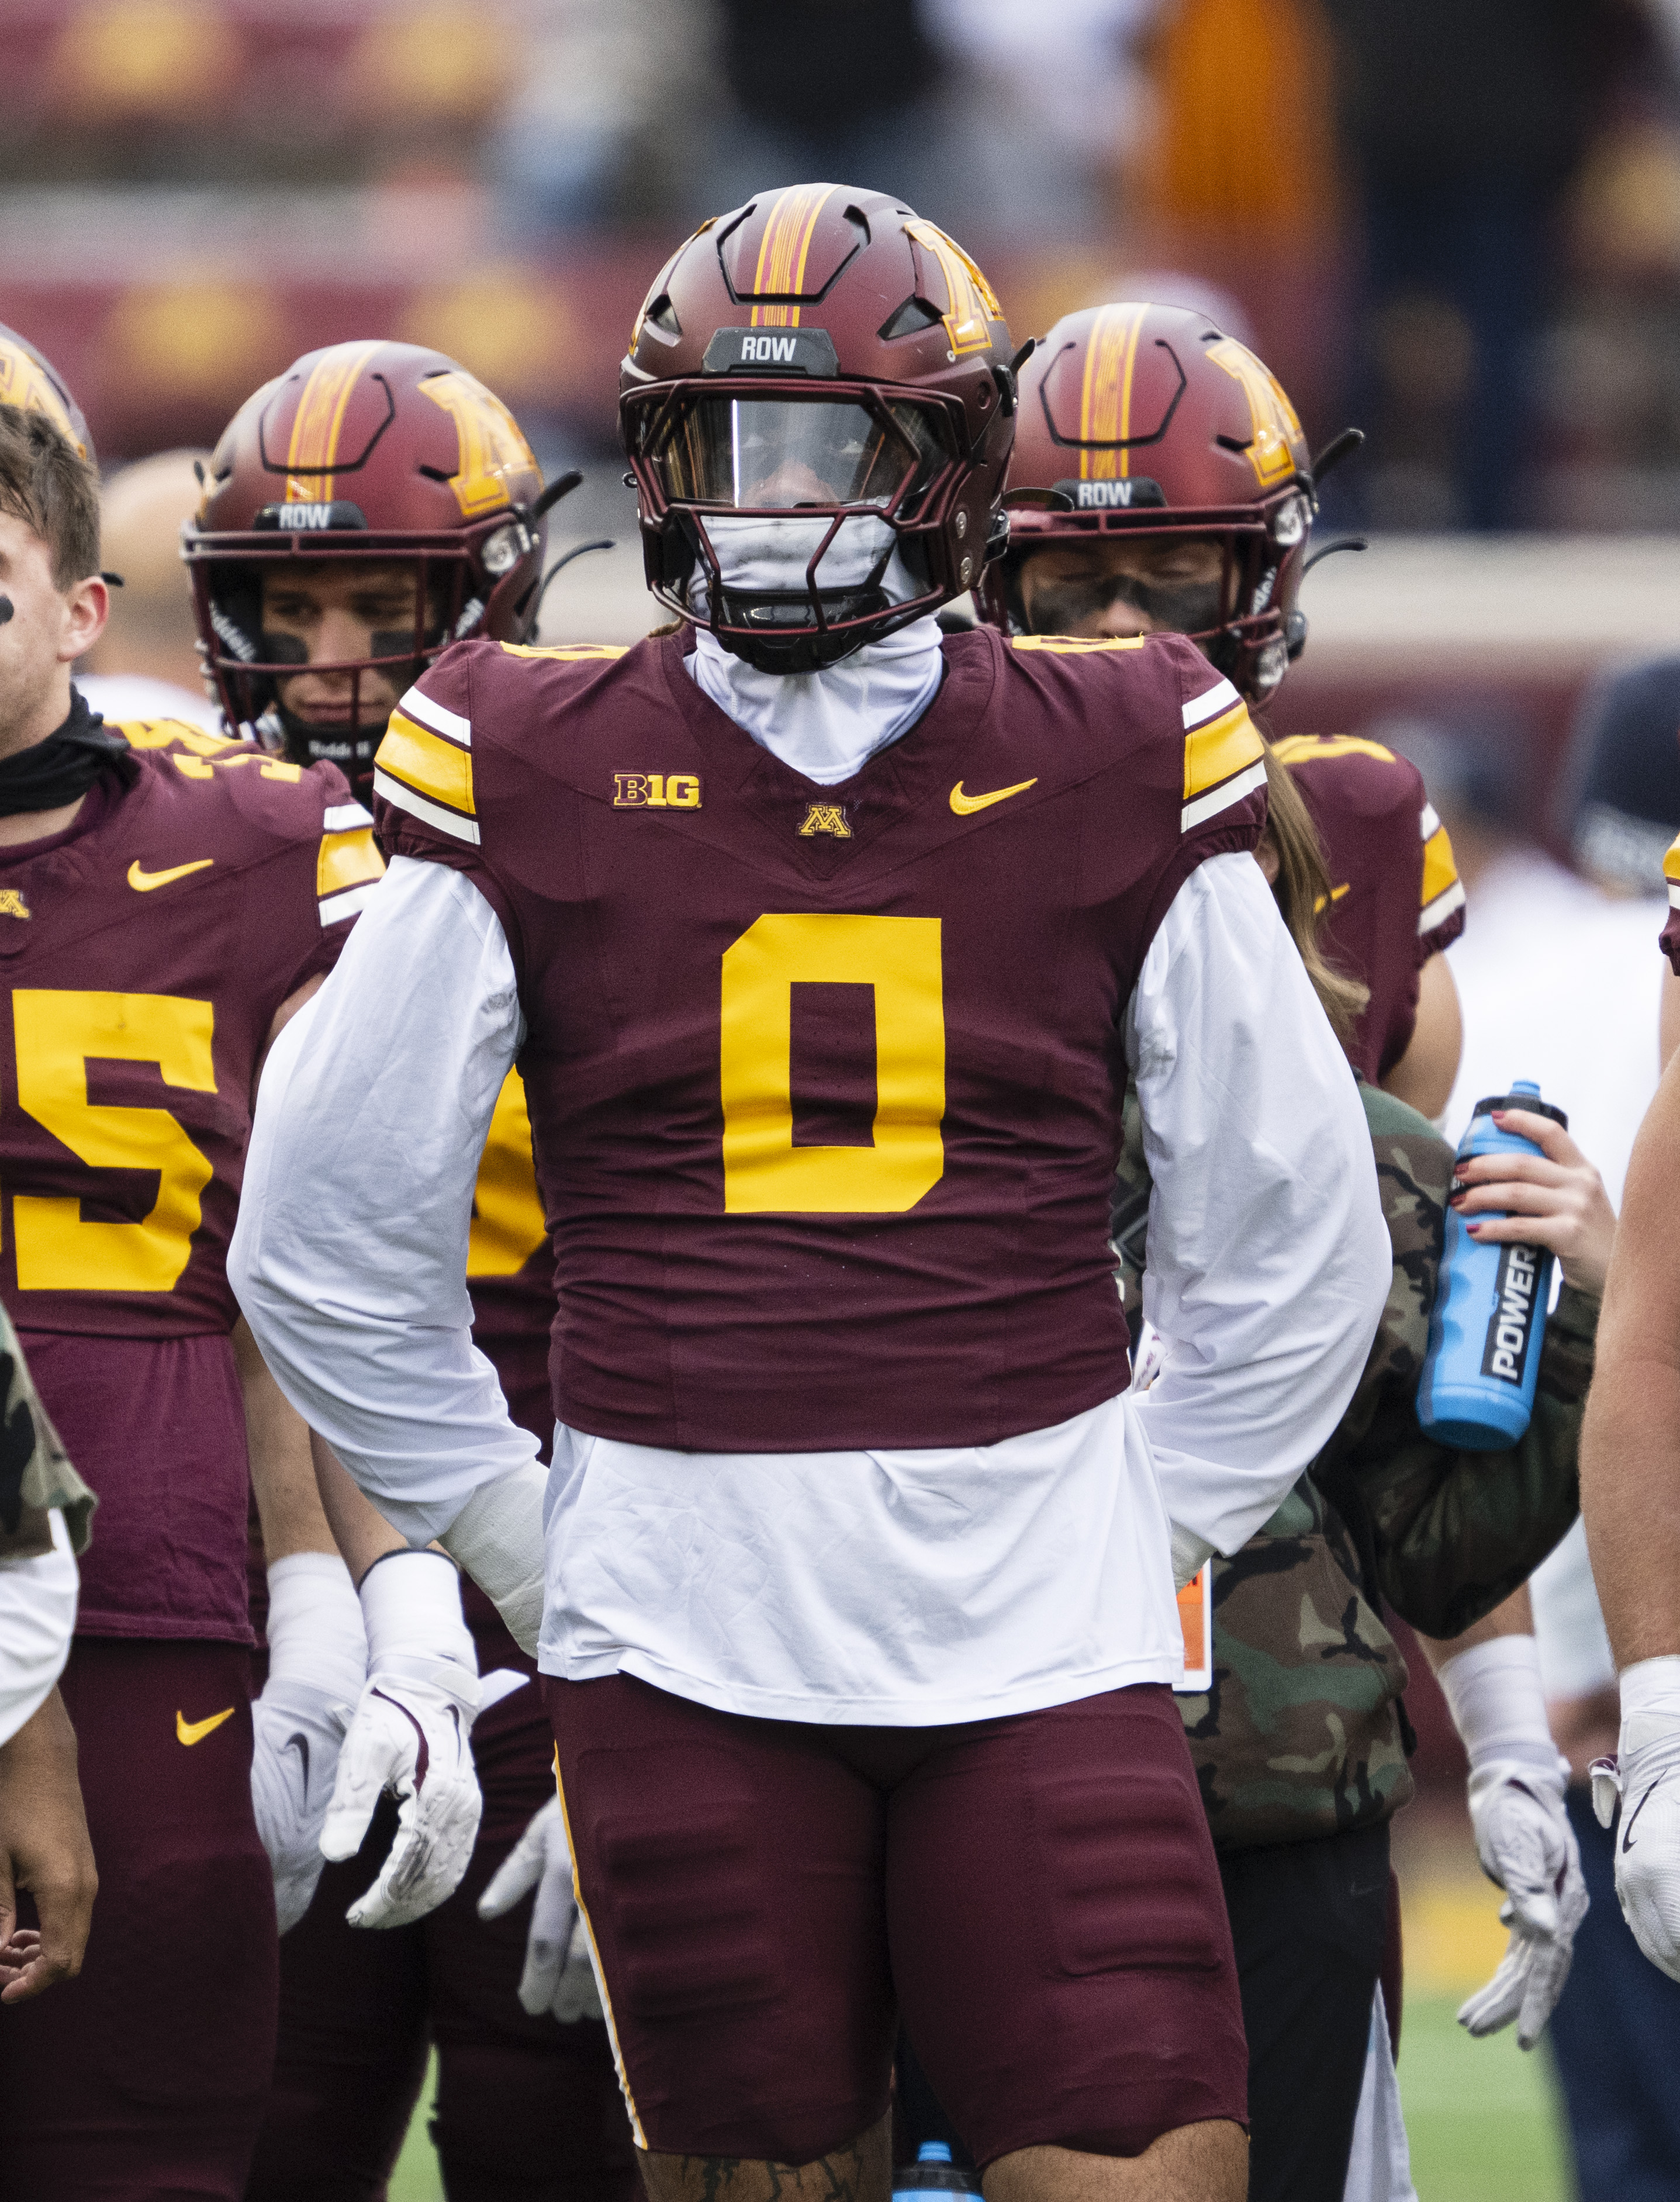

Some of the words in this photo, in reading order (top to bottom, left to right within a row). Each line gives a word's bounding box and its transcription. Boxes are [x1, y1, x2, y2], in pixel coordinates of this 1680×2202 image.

[741, 337, 796, 361] ROW
[1078, 482, 1132, 506] ROW
[279, 504, 331, 528] ROW
[798, 804, 851, 838] M
[721, 913, 946, 1214] 0
[0, 988, 218, 1292] 5
[1492, 1245, 1536, 1381] POWER
